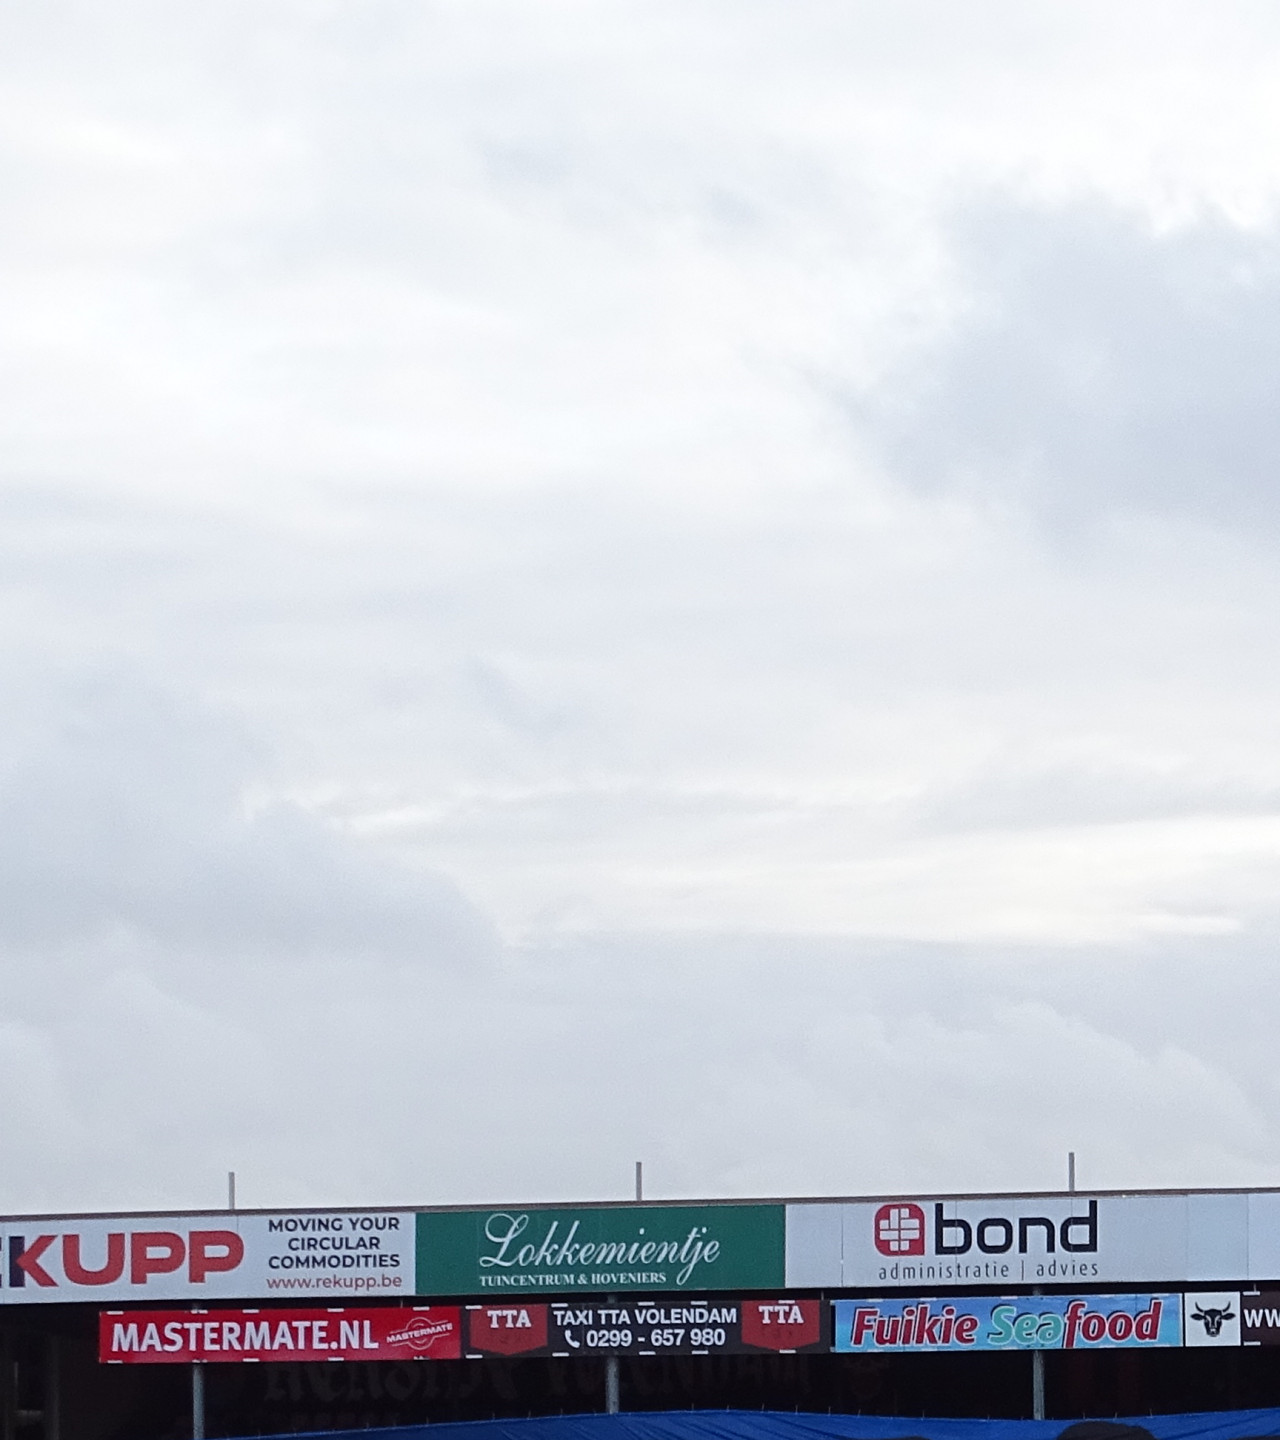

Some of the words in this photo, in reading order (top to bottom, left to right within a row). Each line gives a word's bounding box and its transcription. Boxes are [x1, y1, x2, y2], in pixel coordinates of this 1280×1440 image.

[268, 1216, 343, 1233] MOVING
[348, 1216, 400, 1232] YOUR
[935, 1200, 1098, 1256] bond
[288, 1236, 380, 1251] CIRCULAR
[479, 1212, 720, 1286] Lokkemientje
[0, 1230, 245, 1289] KUPP
[268, 1253, 400, 1270] COMMODITIES
[479, 1273, 575, 1287] TUINCENTRUM
[577, 1273, 588, 1286] &
[590, 1272, 667, 1286] HOVENIERS
[879, 1262, 1010, 1281] administratie
[1036, 1259, 1098, 1277] advies
[266, 1275, 402, 1291] www.rekupp.be
[487, 1309, 531, 1328] TTA
[553, 1309, 593, 1326] TAXI
[597, 1308, 631, 1326] TTA
[634, 1307, 738, 1325] VOLENDAM
[758, 1305, 804, 1325] TTA
[852, 1303, 979, 1346] Fuikie
[987, 1298, 1163, 1349] Seafood
[111, 1320, 380, 1353] MASTERMATE.NL
[386, 1322, 453, 1343] MASTERMATE
[586, 1330, 632, 1348] 0299
[650, 1329, 684, 1347] 657
[689, 1328, 726, 1347] 980
